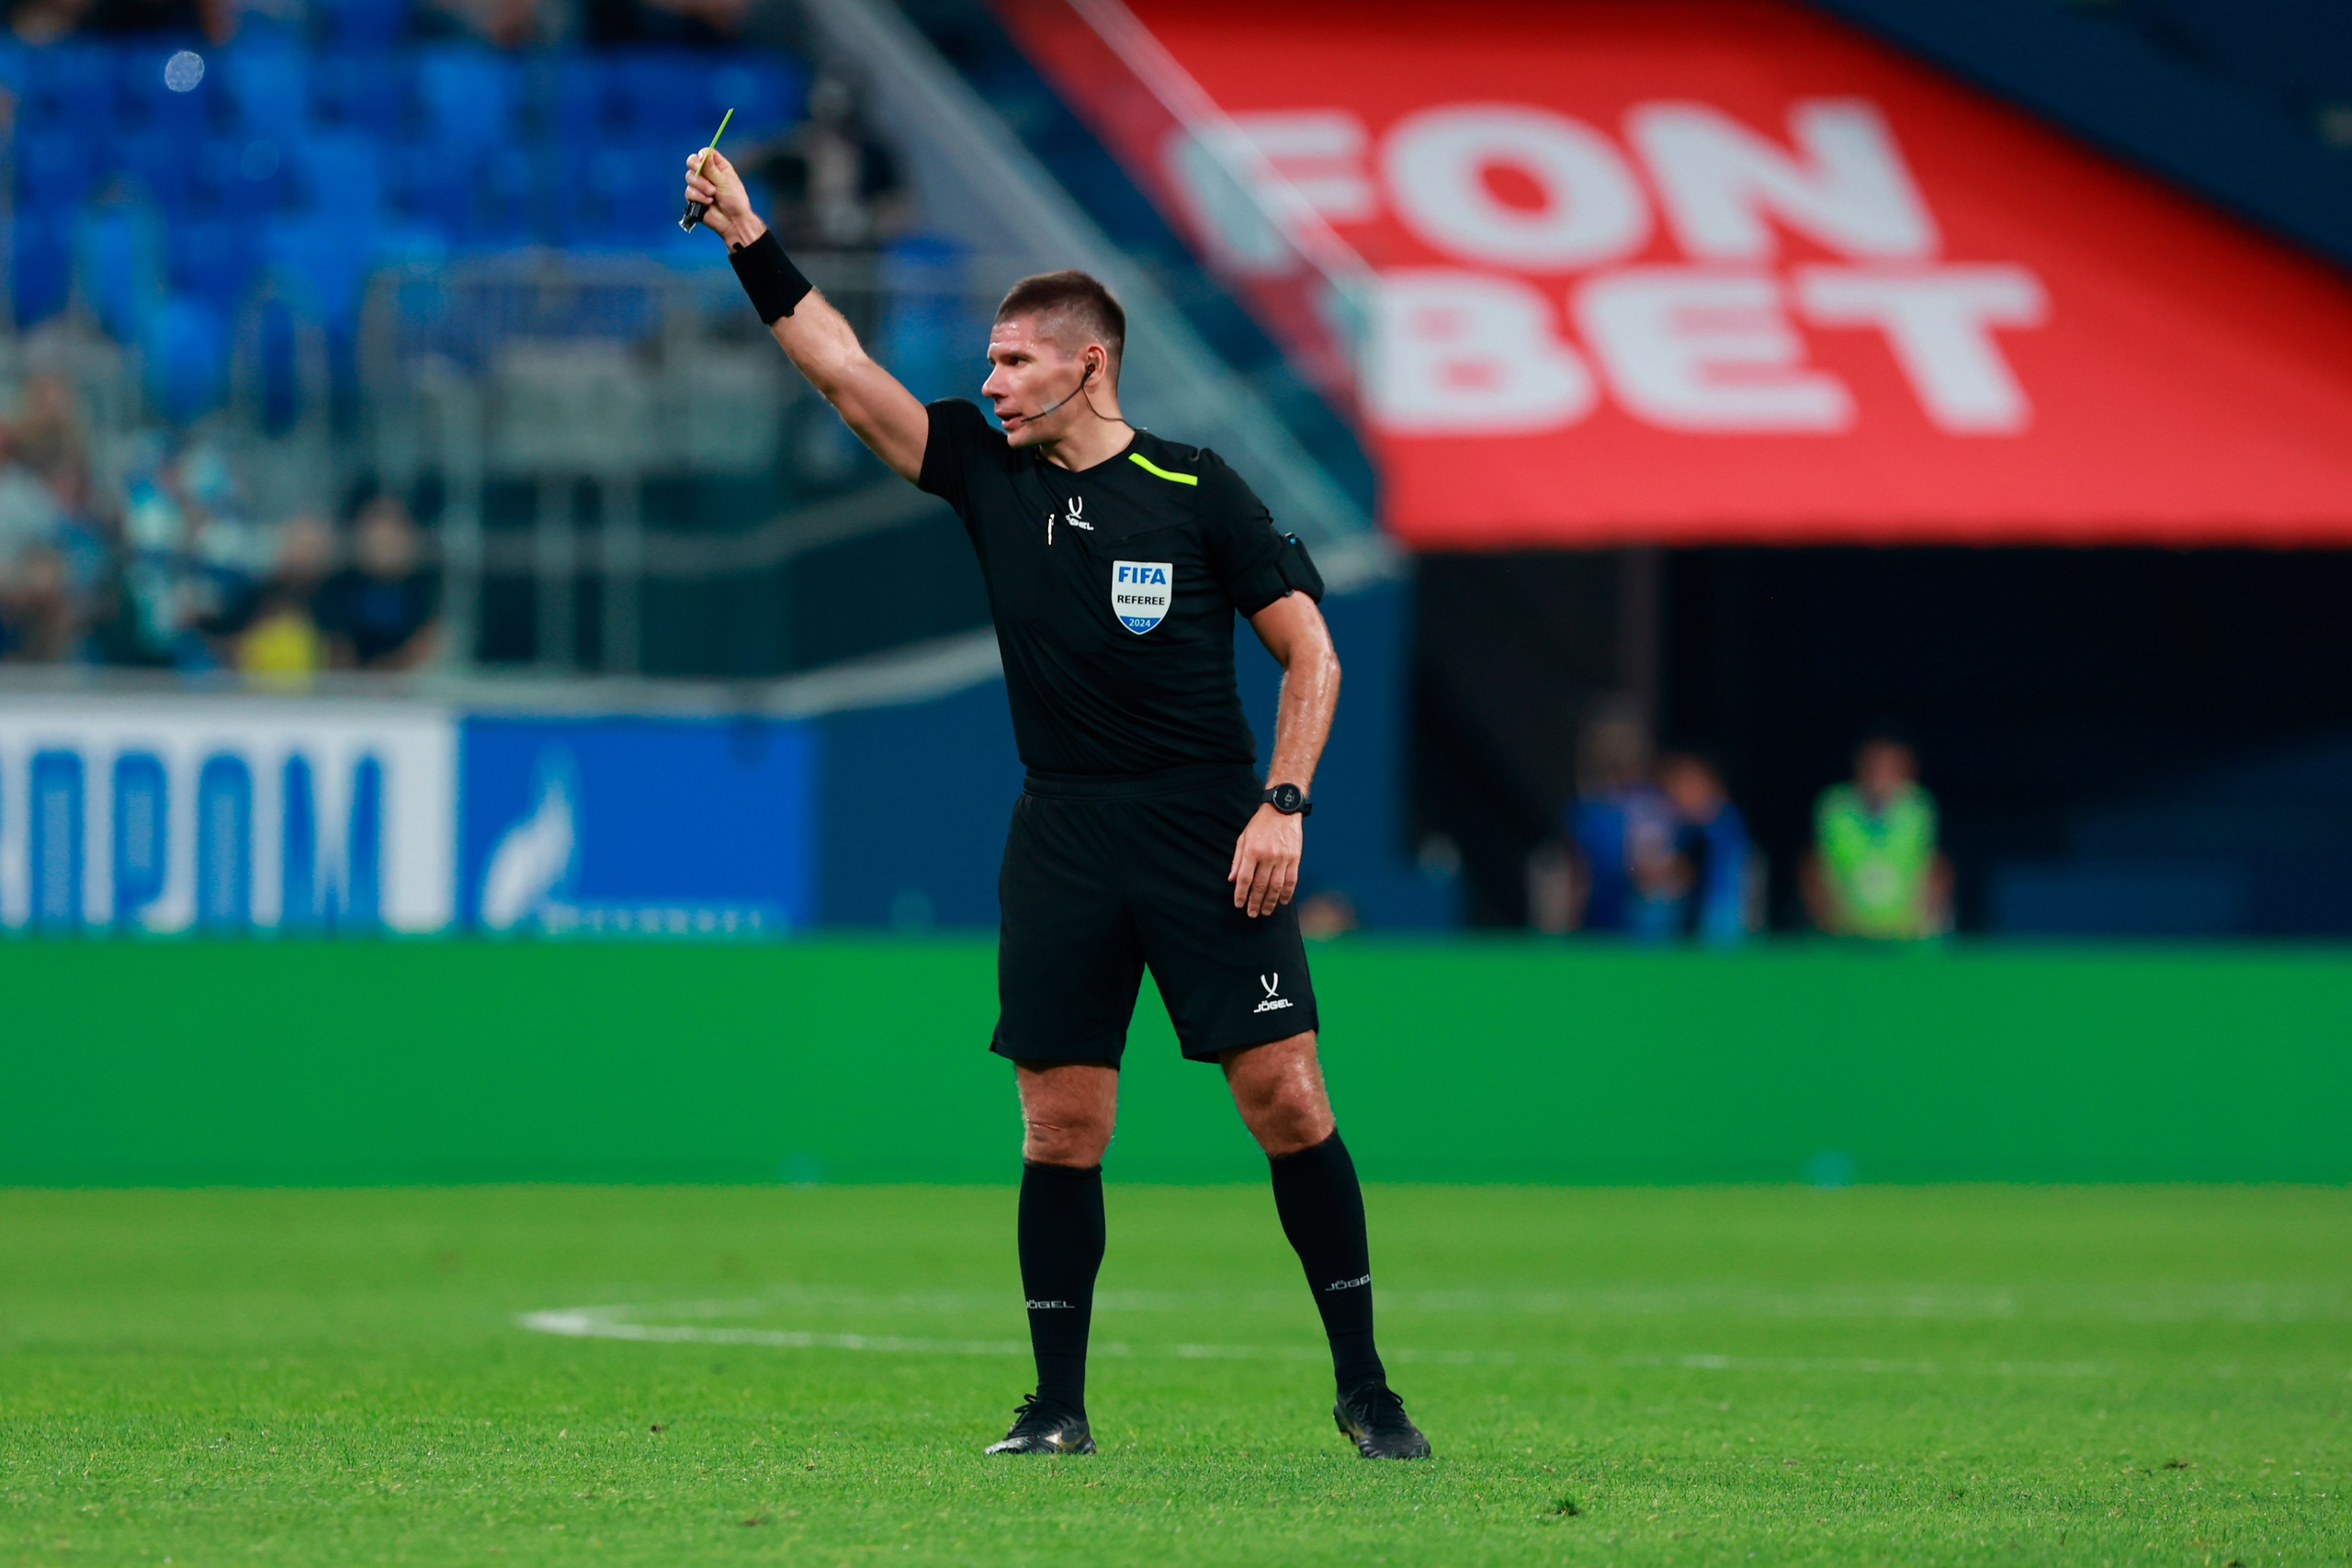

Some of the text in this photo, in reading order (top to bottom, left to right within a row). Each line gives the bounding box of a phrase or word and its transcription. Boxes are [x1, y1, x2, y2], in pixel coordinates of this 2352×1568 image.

[1167, 98, 1940, 275] FON
[1323, 263, 2049, 434] BET
[1118, 566, 1166, 585] FIFA
[1117, 594, 1165, 605] REFEREE
[1129, 618, 1151, 627] 2024
[1253, 998, 1294, 1013] JÖGEL
